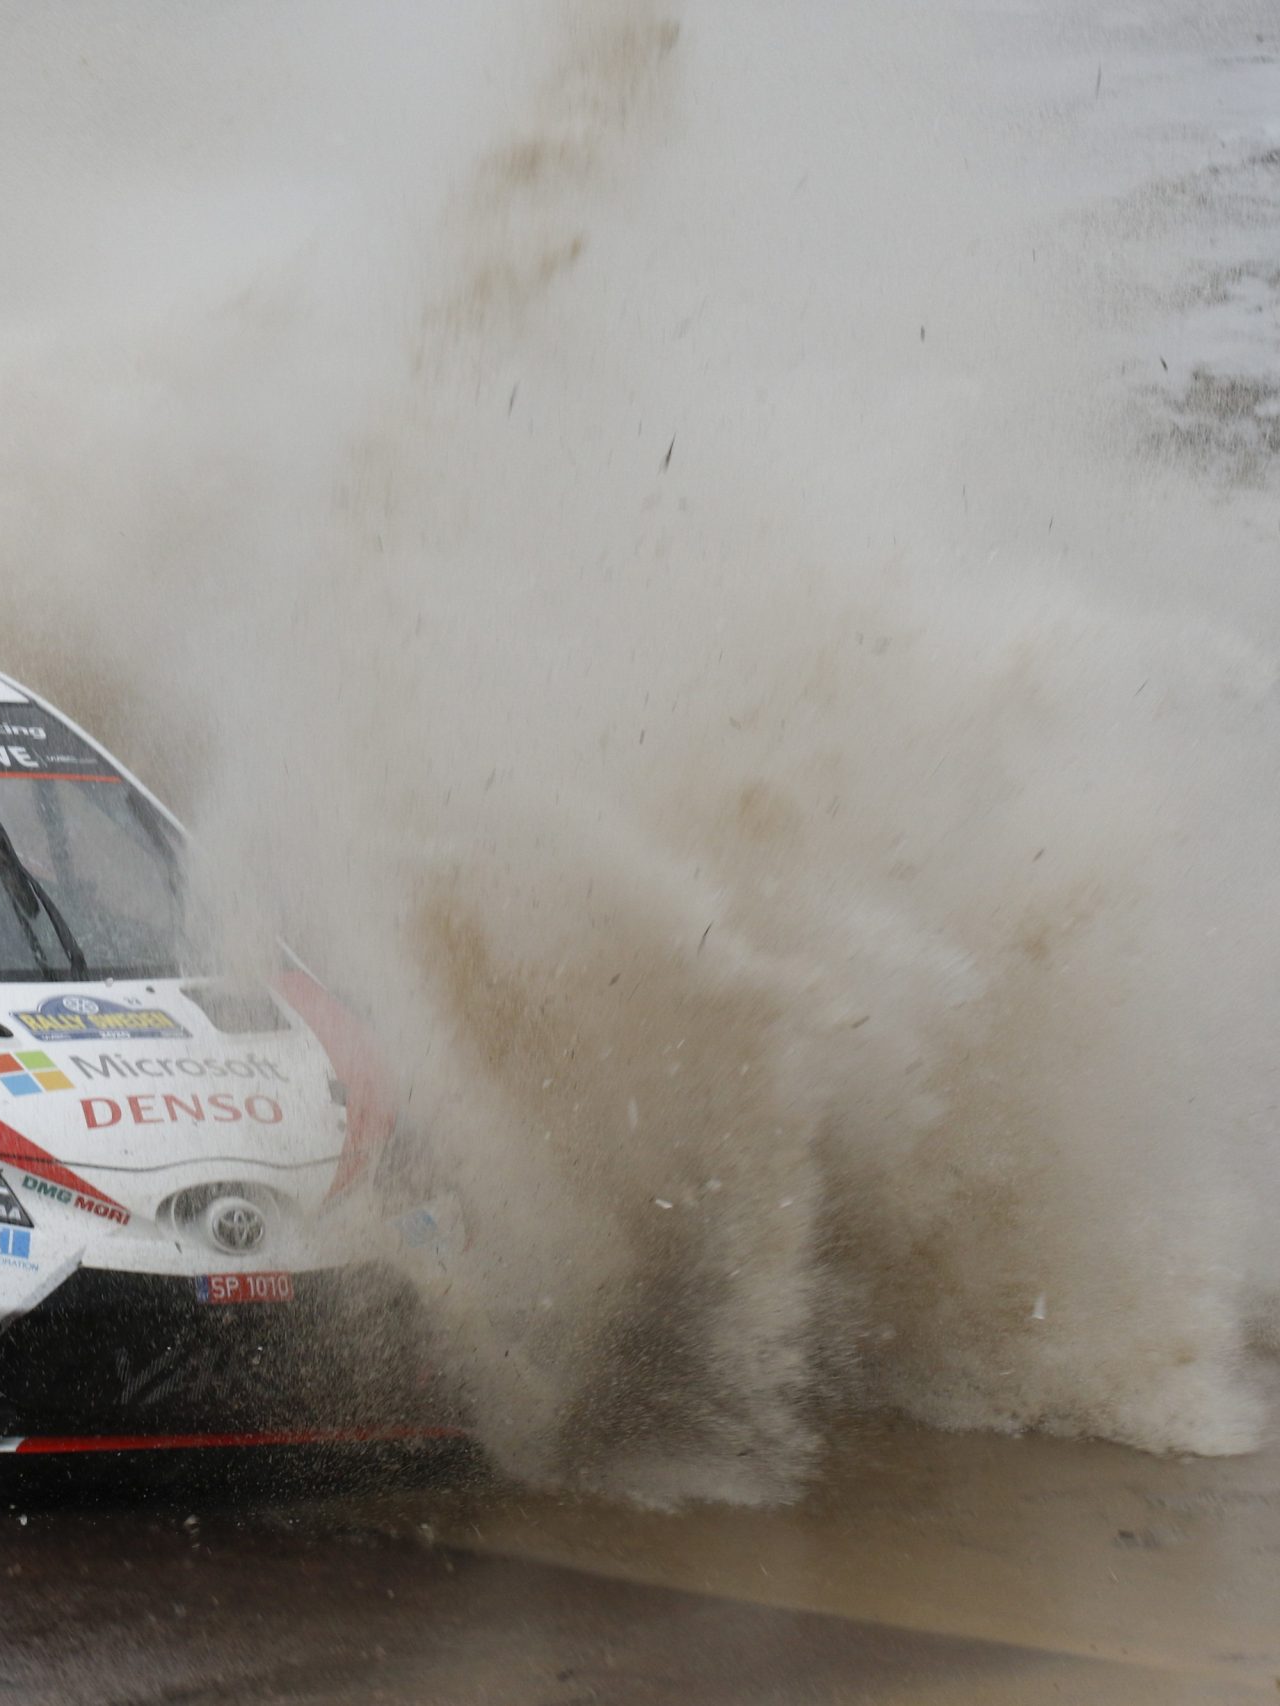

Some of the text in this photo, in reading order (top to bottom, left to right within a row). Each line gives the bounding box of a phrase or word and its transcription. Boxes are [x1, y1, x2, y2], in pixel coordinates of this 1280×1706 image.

[21, 1013, 87, 1031] RALLY
[70, 1053, 289, 1083] Microsoft
[80, 1093, 284, 1129] DENSO
[22, 1174, 131, 1226] DMG MORI
[210, 1275, 290, 1298] SP 1010
